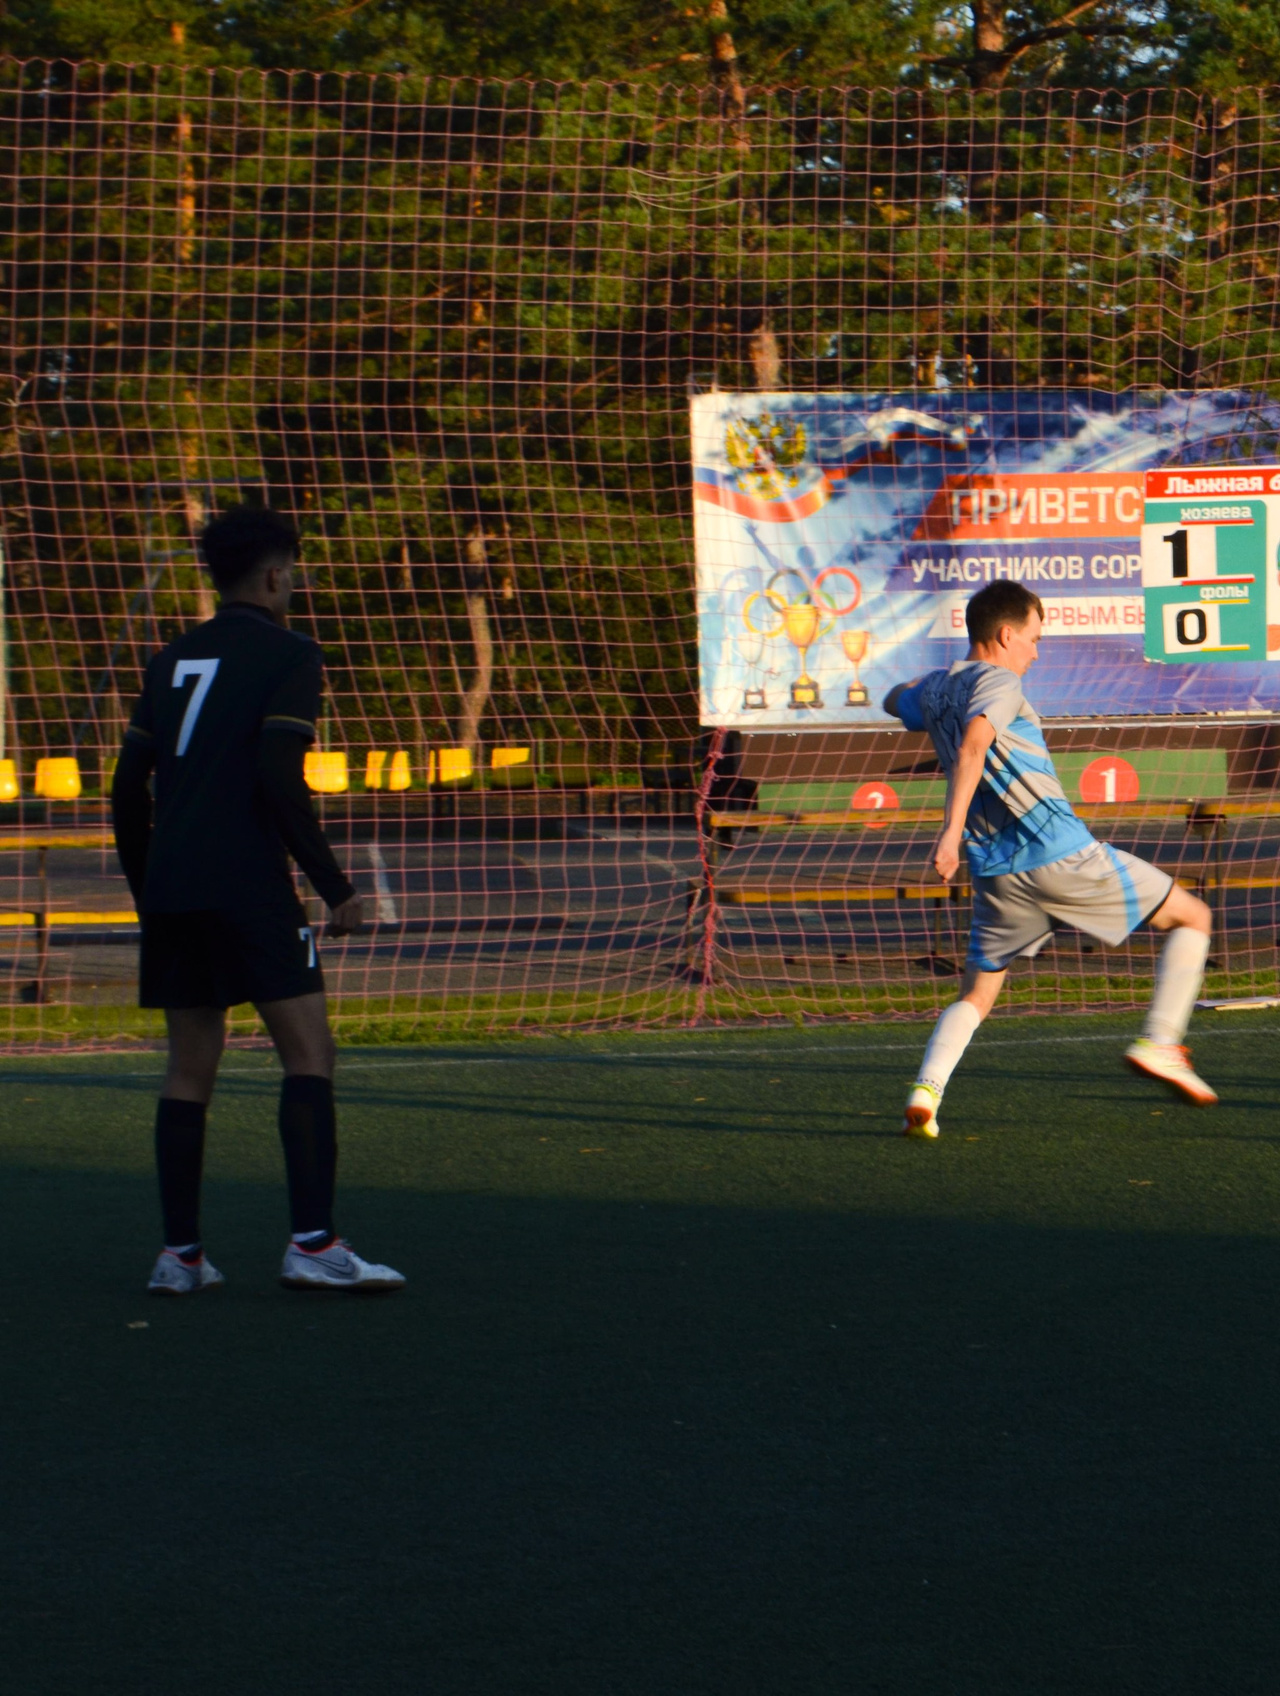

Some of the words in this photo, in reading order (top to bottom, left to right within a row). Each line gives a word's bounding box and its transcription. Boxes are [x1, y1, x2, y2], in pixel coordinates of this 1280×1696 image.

[1164, 475, 1264, 494] Лыжная
[952, 486, 1143, 524] ПРИВЕТС
[1180, 506, 1252, 520] хозяева
[911, 556, 1084, 583] УЧАСТНИКОВ
[1163, 529, 1188, 578] 1
[1200, 586, 1249, 600] фолы
[1041, 606, 1118, 626] РВЫМ
[1176, 608, 1207, 645] 0
[171, 658, 221, 756] 7
[1099, 768, 1116, 802] 1
[298, 927, 315, 968] 7
